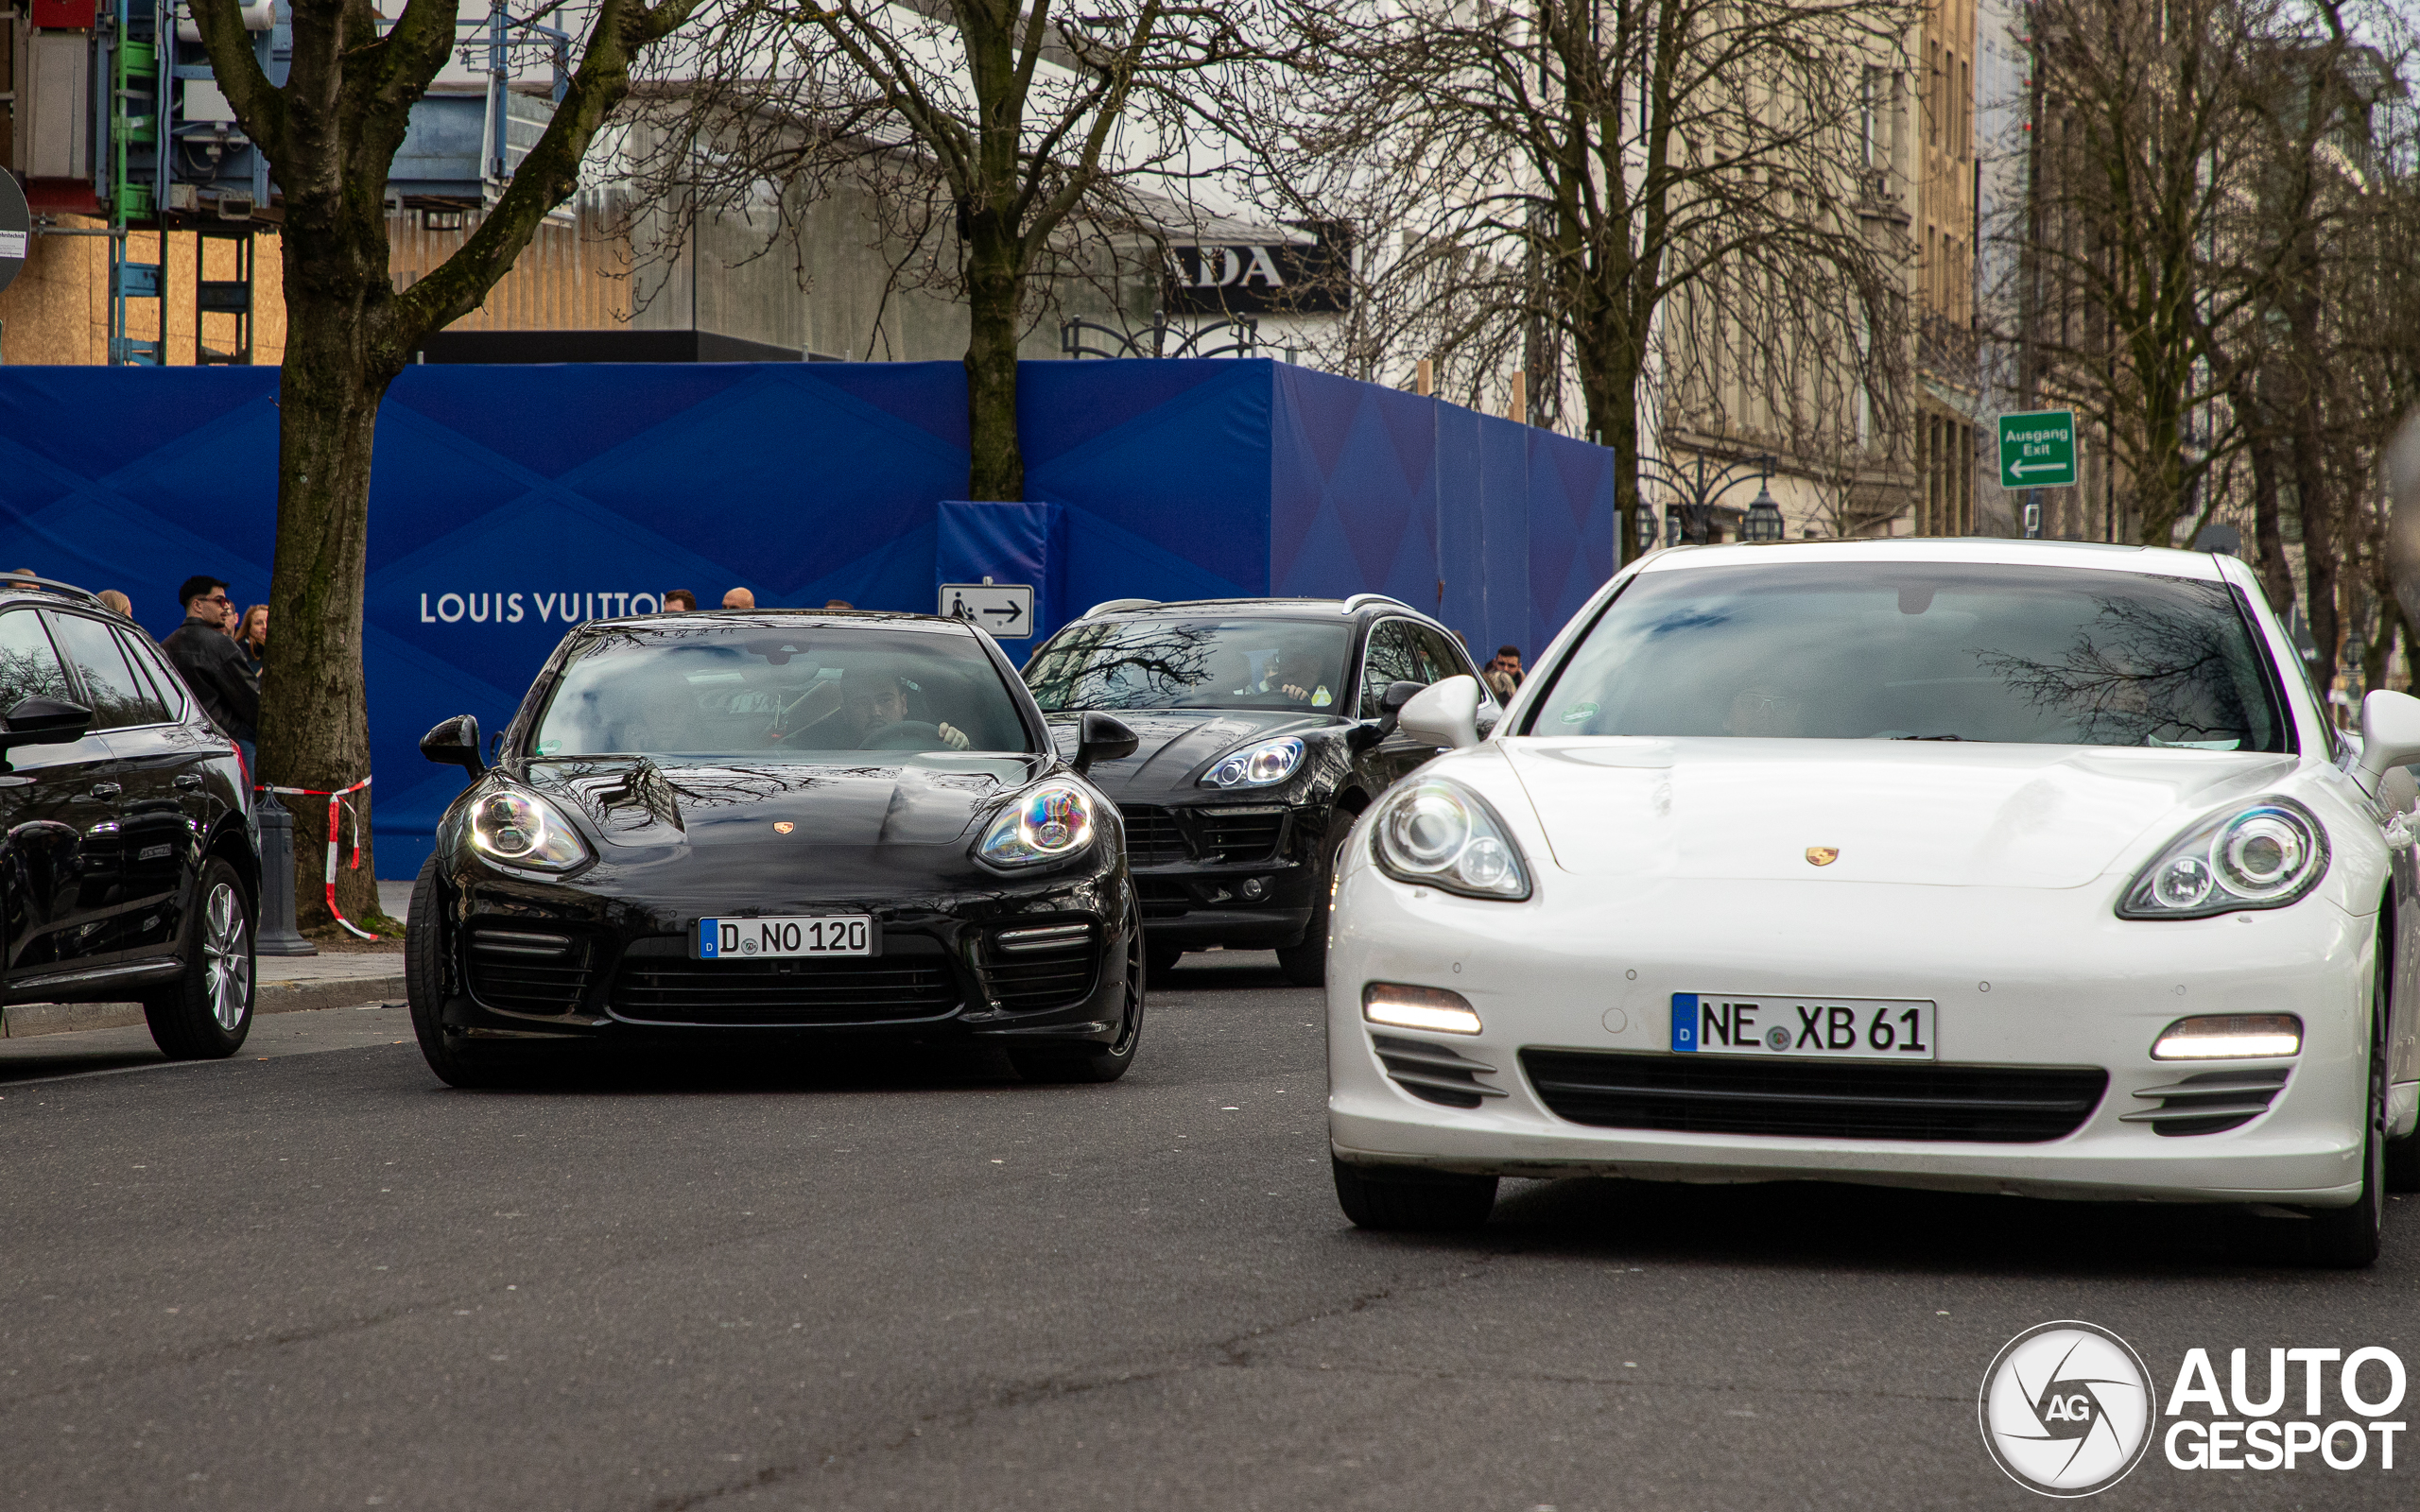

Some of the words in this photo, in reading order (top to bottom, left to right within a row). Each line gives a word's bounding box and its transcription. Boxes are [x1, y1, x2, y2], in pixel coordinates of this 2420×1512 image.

[2006, 428, 2068, 443] Ausgang
[2023, 442, 2050, 456] Exit
[421, 593, 525, 623] LOUIS
[533, 593, 666, 623] VUITTO
[720, 923, 738, 953] D
[762, 922, 802, 953] NO
[809, 921, 866, 952] 120
[706, 942, 714, 952] D
[1680, 1028, 1690, 1040] D
[1703, 1003, 1761, 1046] NE
[1796, 1005, 1856, 1050] XB
[1869, 1006, 1926, 1052] 61
